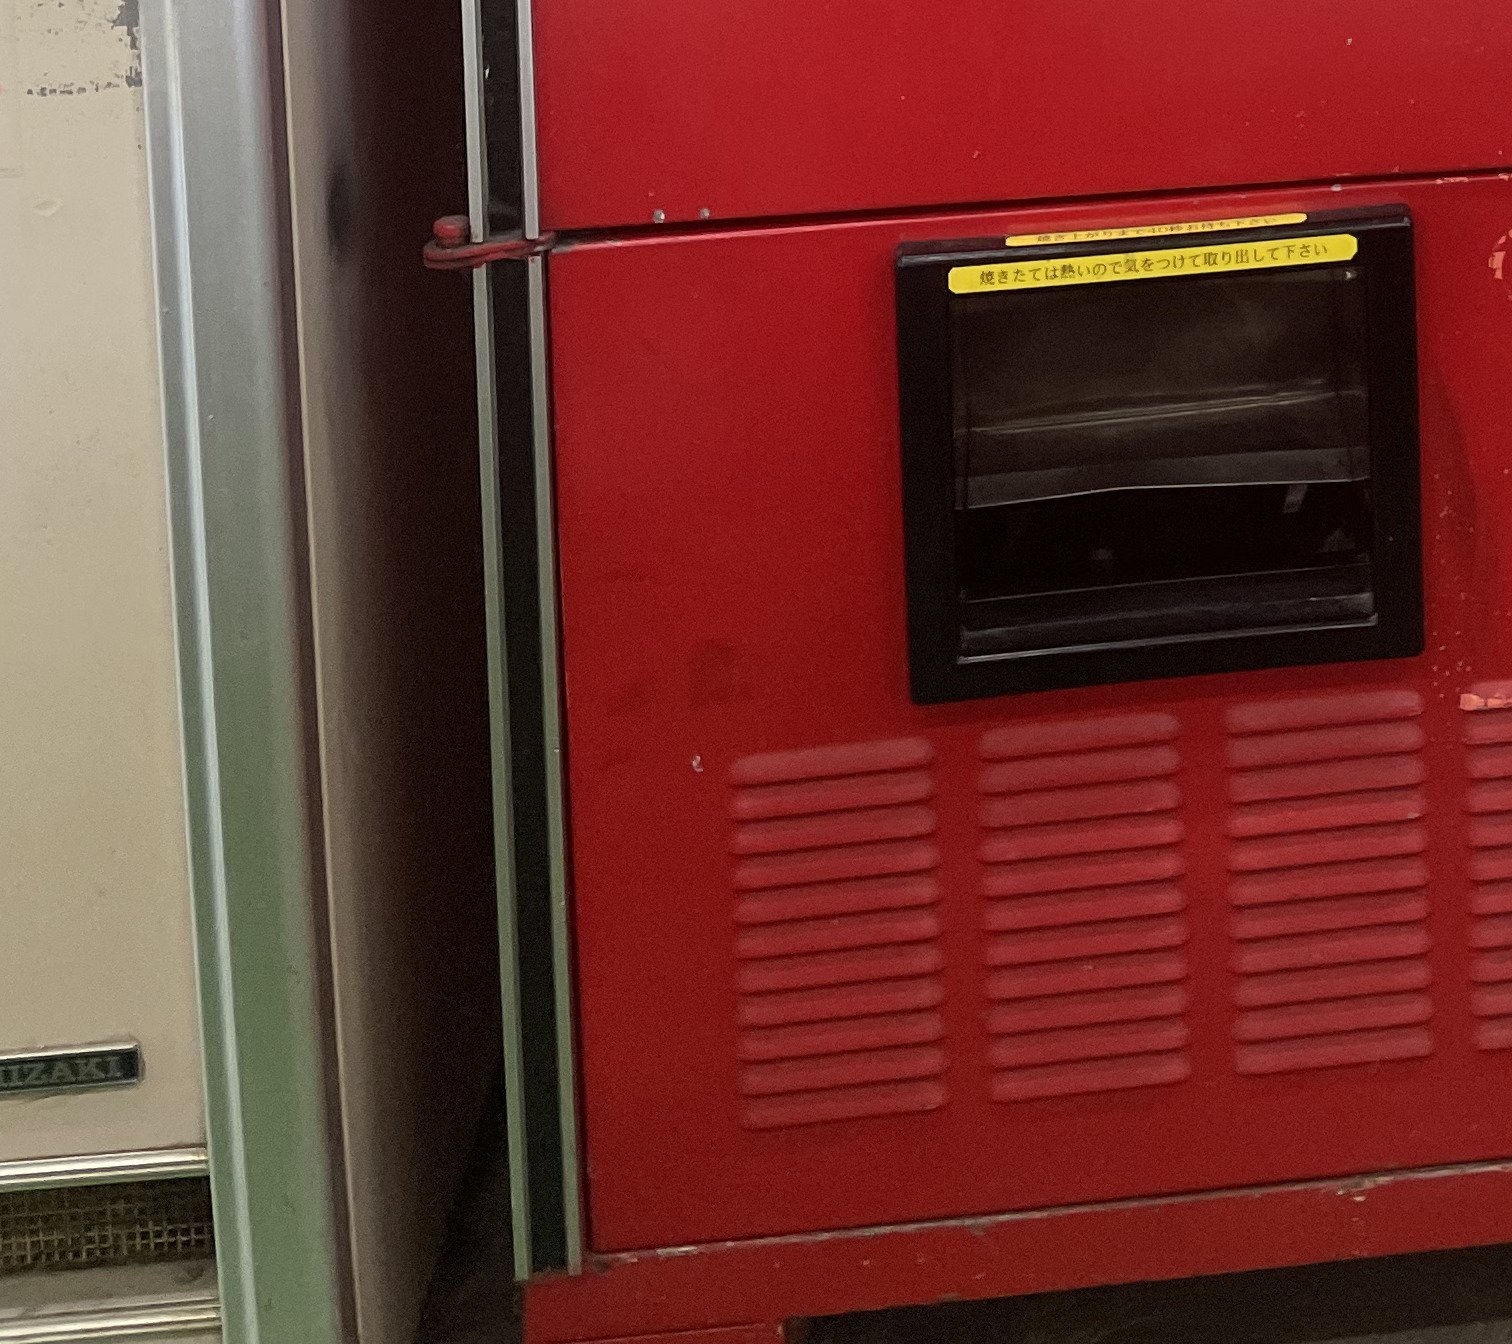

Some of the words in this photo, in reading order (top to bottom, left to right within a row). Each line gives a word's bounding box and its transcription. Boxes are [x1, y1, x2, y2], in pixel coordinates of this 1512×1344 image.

[979, 242, 1329, 287] 焼きたては熱いので気をつけて取り出して下さい
